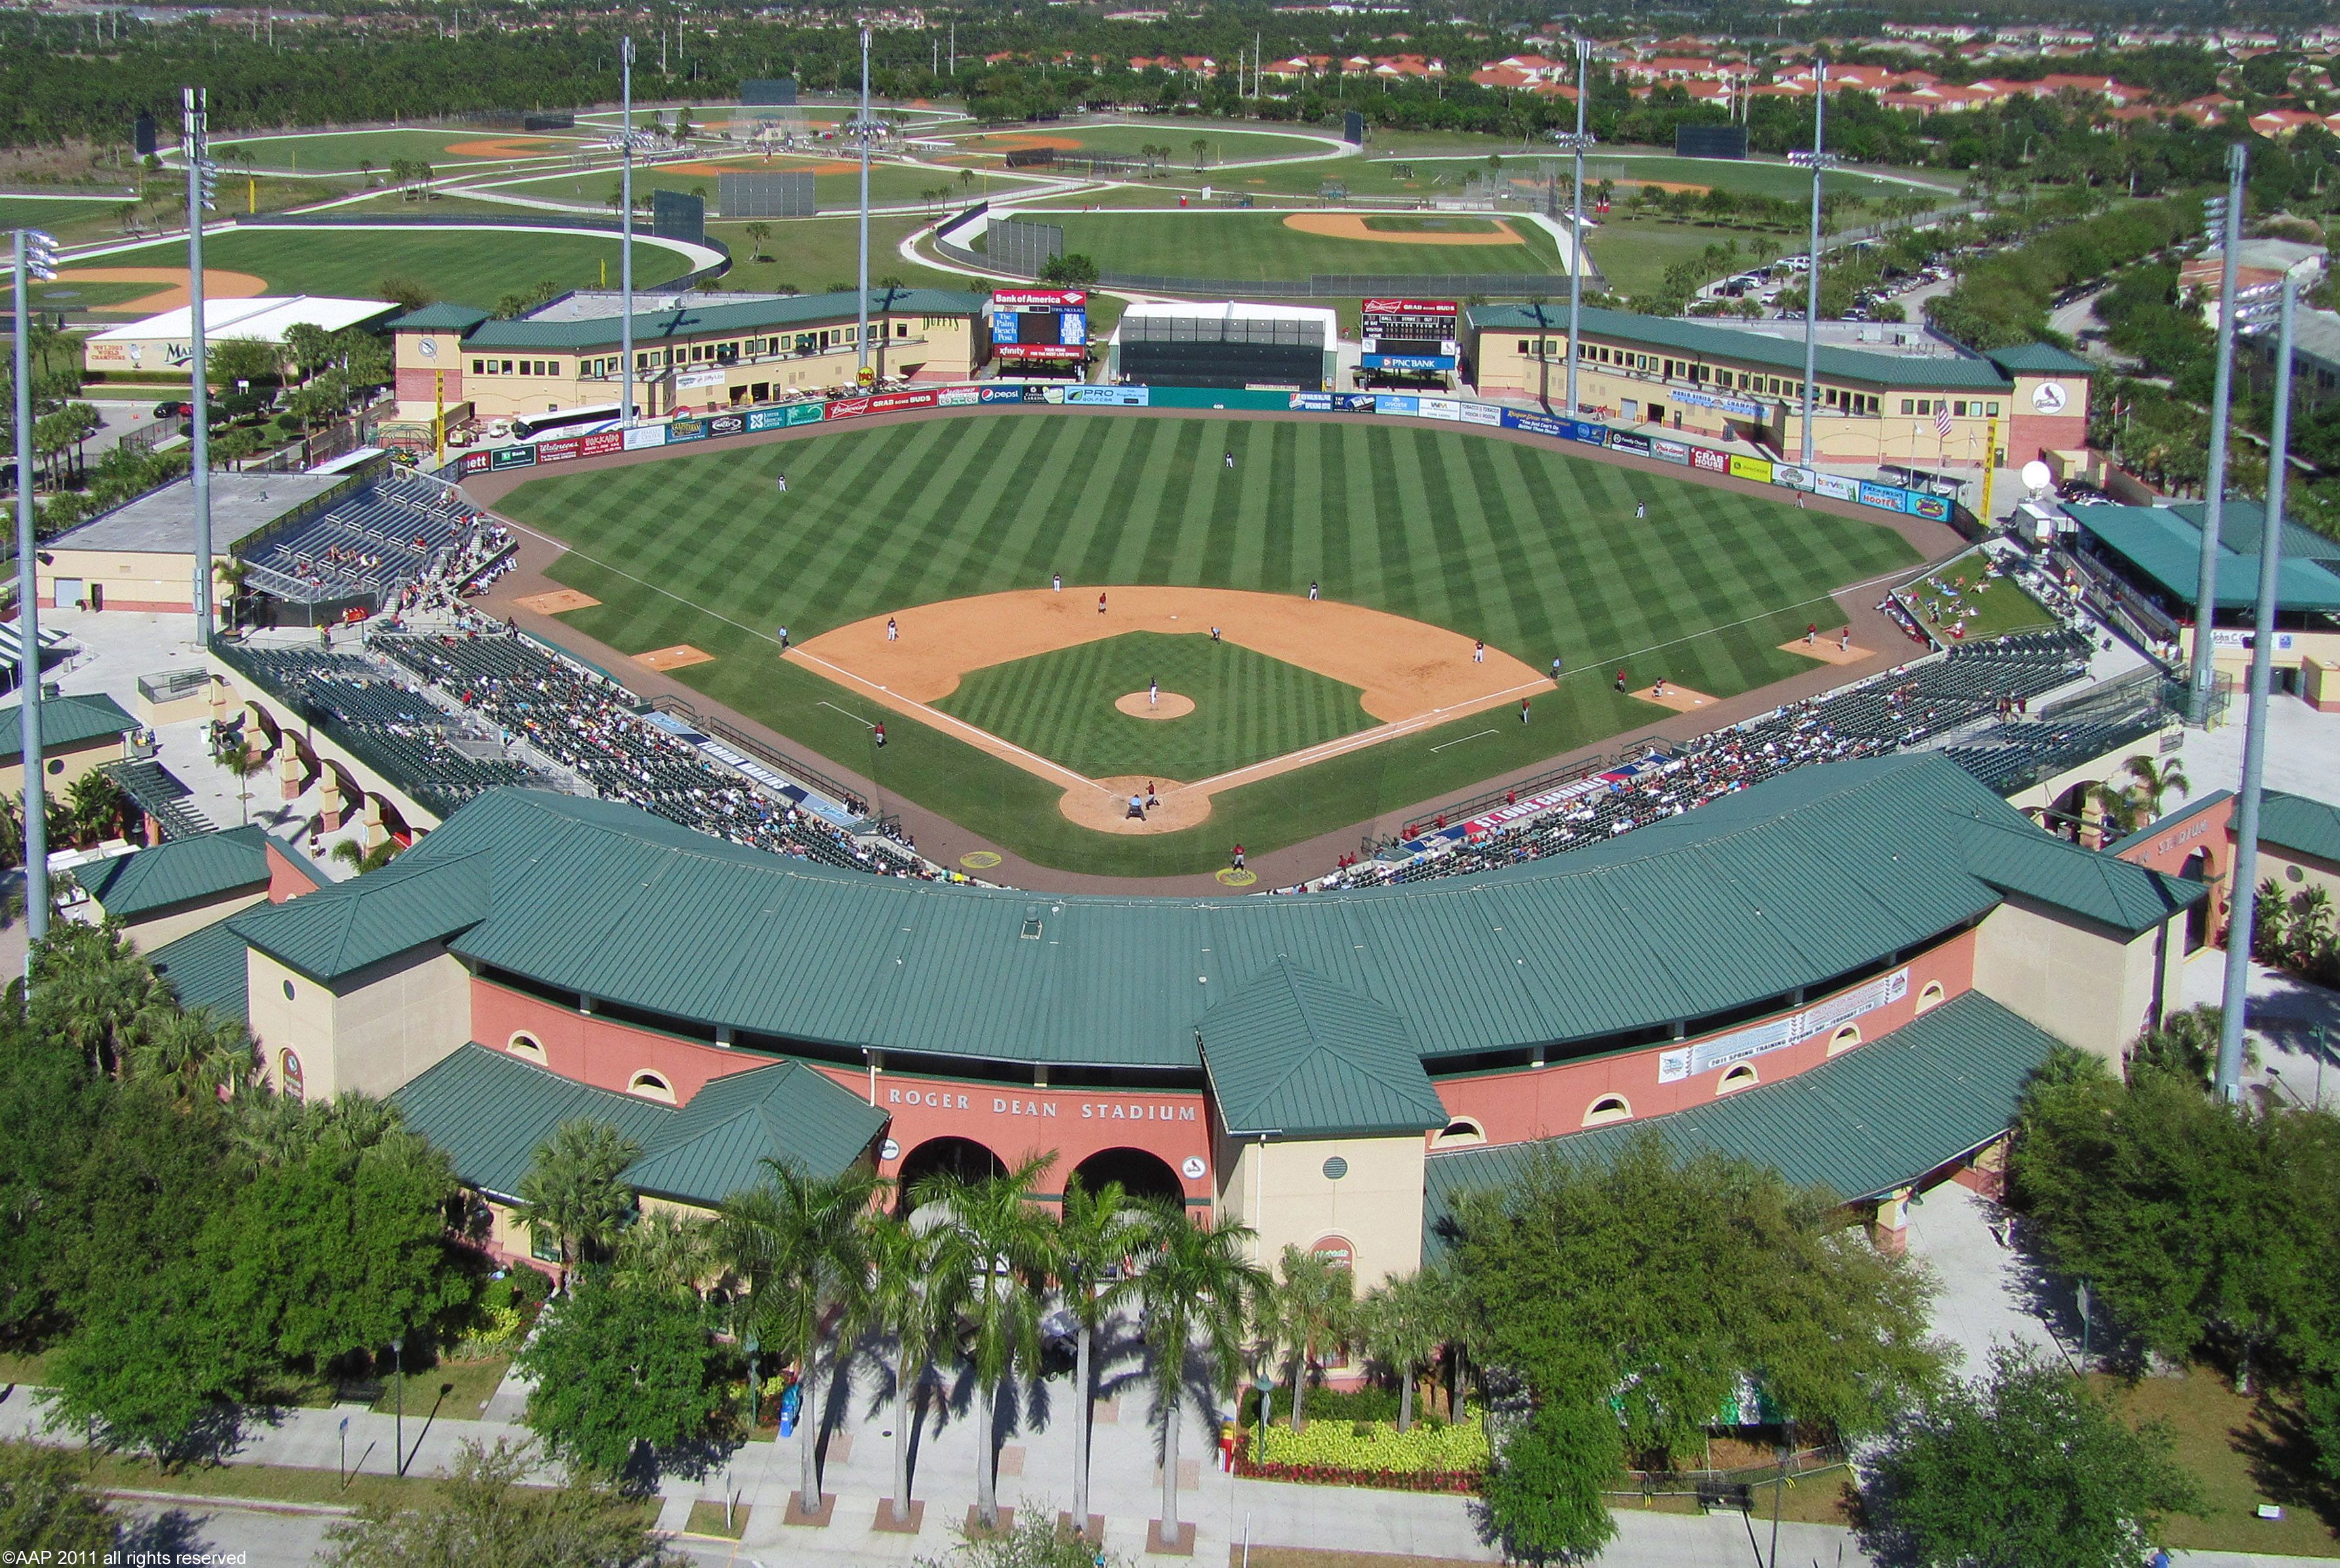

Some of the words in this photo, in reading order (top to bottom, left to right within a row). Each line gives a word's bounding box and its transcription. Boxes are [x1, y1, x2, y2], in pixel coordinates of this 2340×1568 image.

[996, 294, 1017, 302] Bank
[1017, 295, 1026, 303] of
[1027, 295, 1061, 304] America
[1061, 329, 1084, 337] STARTS
[999, 346, 1025, 356] xfinity
[994, 390, 1019, 399] pepsi
[873, 399, 894, 407] GRAB
[910, 395, 932, 403] BUDS
[1508, 410, 1527, 419] Roger
[539, 442, 579, 452] Walgreens
[1695, 451, 1723, 463] CRAB
[1695, 458, 1724, 469] HOUSE
[1817, 478, 1844, 489] tervis
[1864, 495, 1899, 509] HOOTER
[697, 741, 745, 766] FLORIDA
[737, 763, 790, 789] MARLINS
[1474, 814, 1500, 829] ST.
[1500, 801, 1540, 821] LOUIS
[1536, 777, 1610, 806] CARDINALS
[1711, 1057, 1727, 1067] 2011
[1729, 1050, 1754, 1062] SPRING
[1755, 1039, 1786, 1052] TRAINING
[1788, 1030, 1813, 1043] OPENING
[889, 1088, 970, 1109] ROGER
[993, 1098, 1057, 1117] DEAN
[1081, 1103, 1195, 1121] STADIUM
